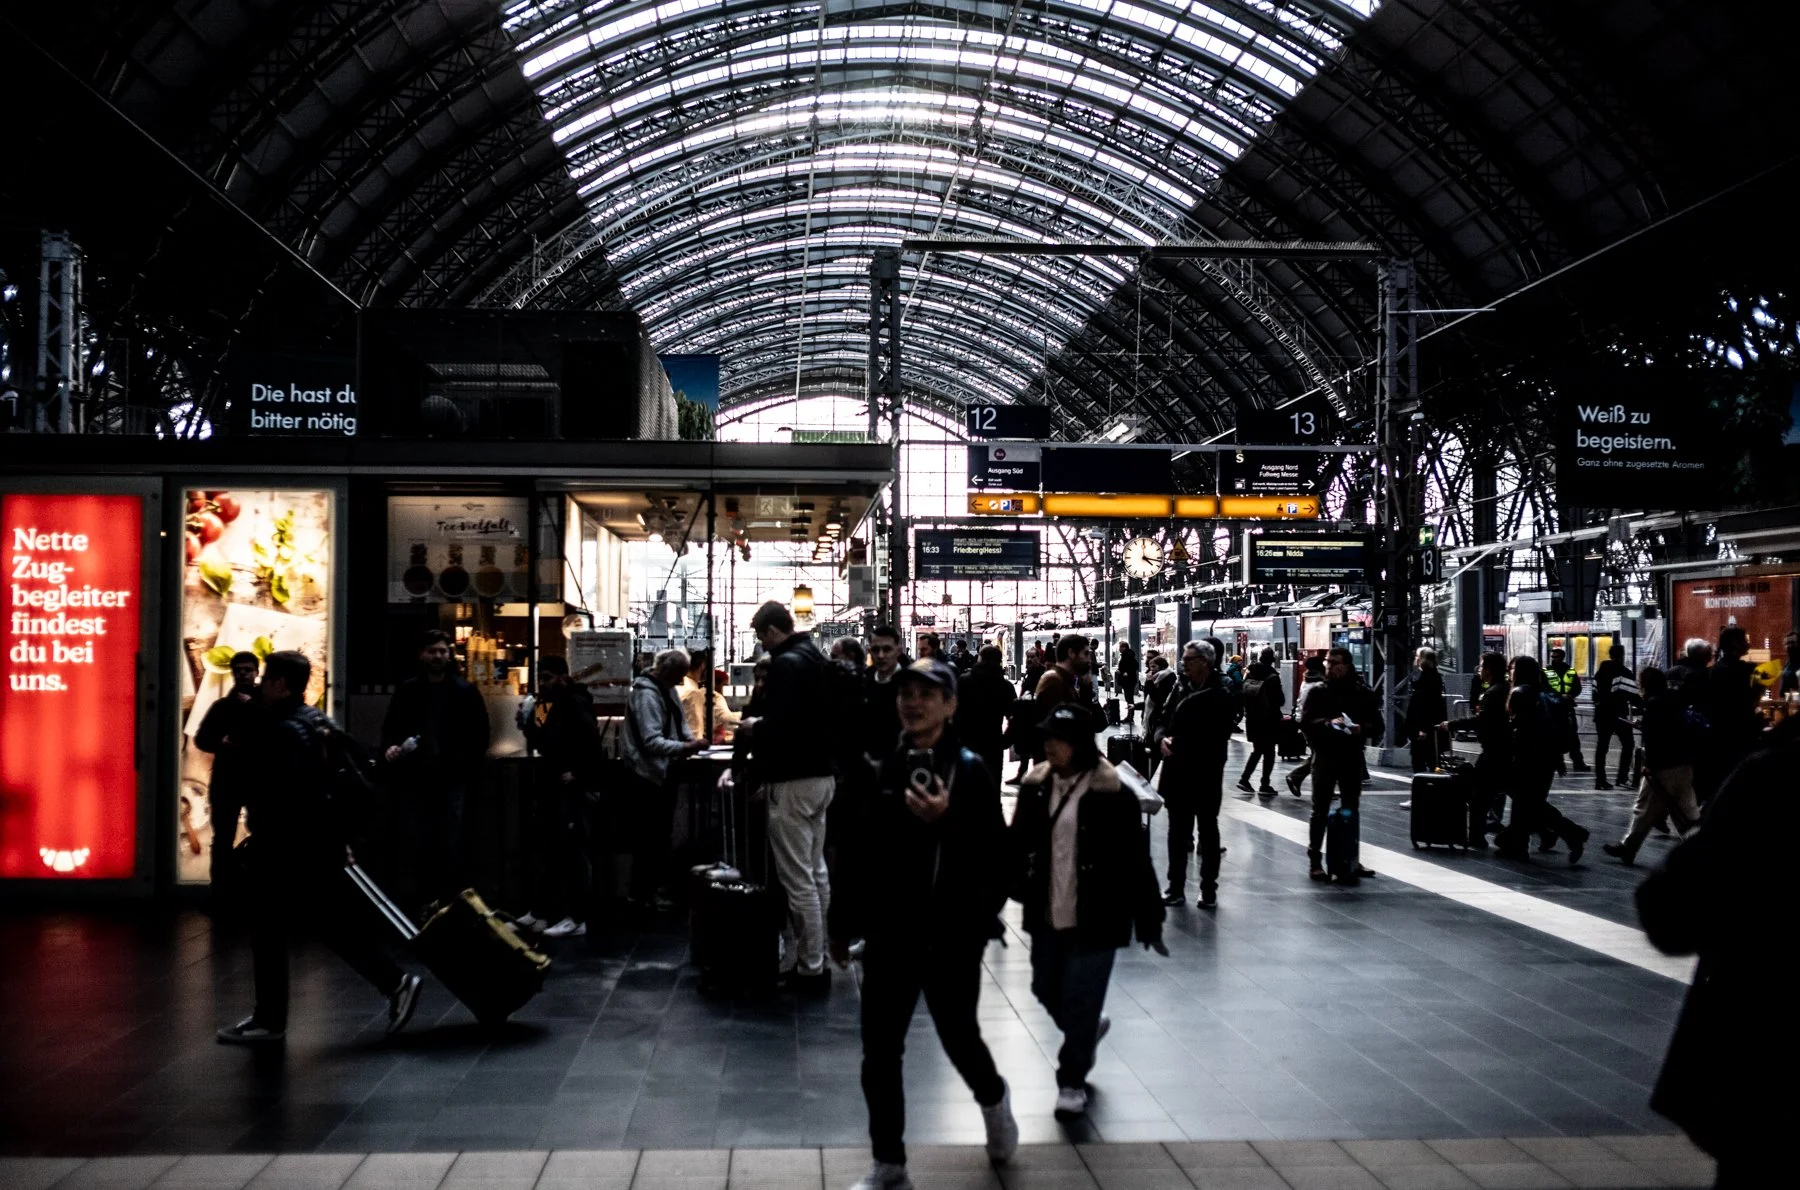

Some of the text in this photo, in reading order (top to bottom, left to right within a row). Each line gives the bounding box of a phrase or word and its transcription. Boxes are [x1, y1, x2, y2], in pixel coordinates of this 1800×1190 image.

[251, 382, 357, 404] Die hast du
[251, 408, 357, 436] bitter nötig
[970, 407, 997, 430] 12
[1290, 411, 1315, 435] 13
[1577, 404, 1651, 425] Weiß zu
[1576, 428, 1677, 454] begeistern.
[1235, 453, 1245, 464] S
[1261, 464, 1285, 472] Ausgang
[1576, 458, 1705, 471] Ganz ohne zugesetzte Aromen
[987, 467, 1011, 475] Ausgang
[12, 528, 88, 551] Nette
[953, 546, 1003, 555] Friedberg(Hess)
[12, 556, 75, 584] Zug-
[1421, 550, 1433, 576] 13
[11, 583, 130, 612] begleiter
[11, 611, 107, 636] findest
[10, 639, 94, 664] du bei
[10, 671, 68, 692] uns.
